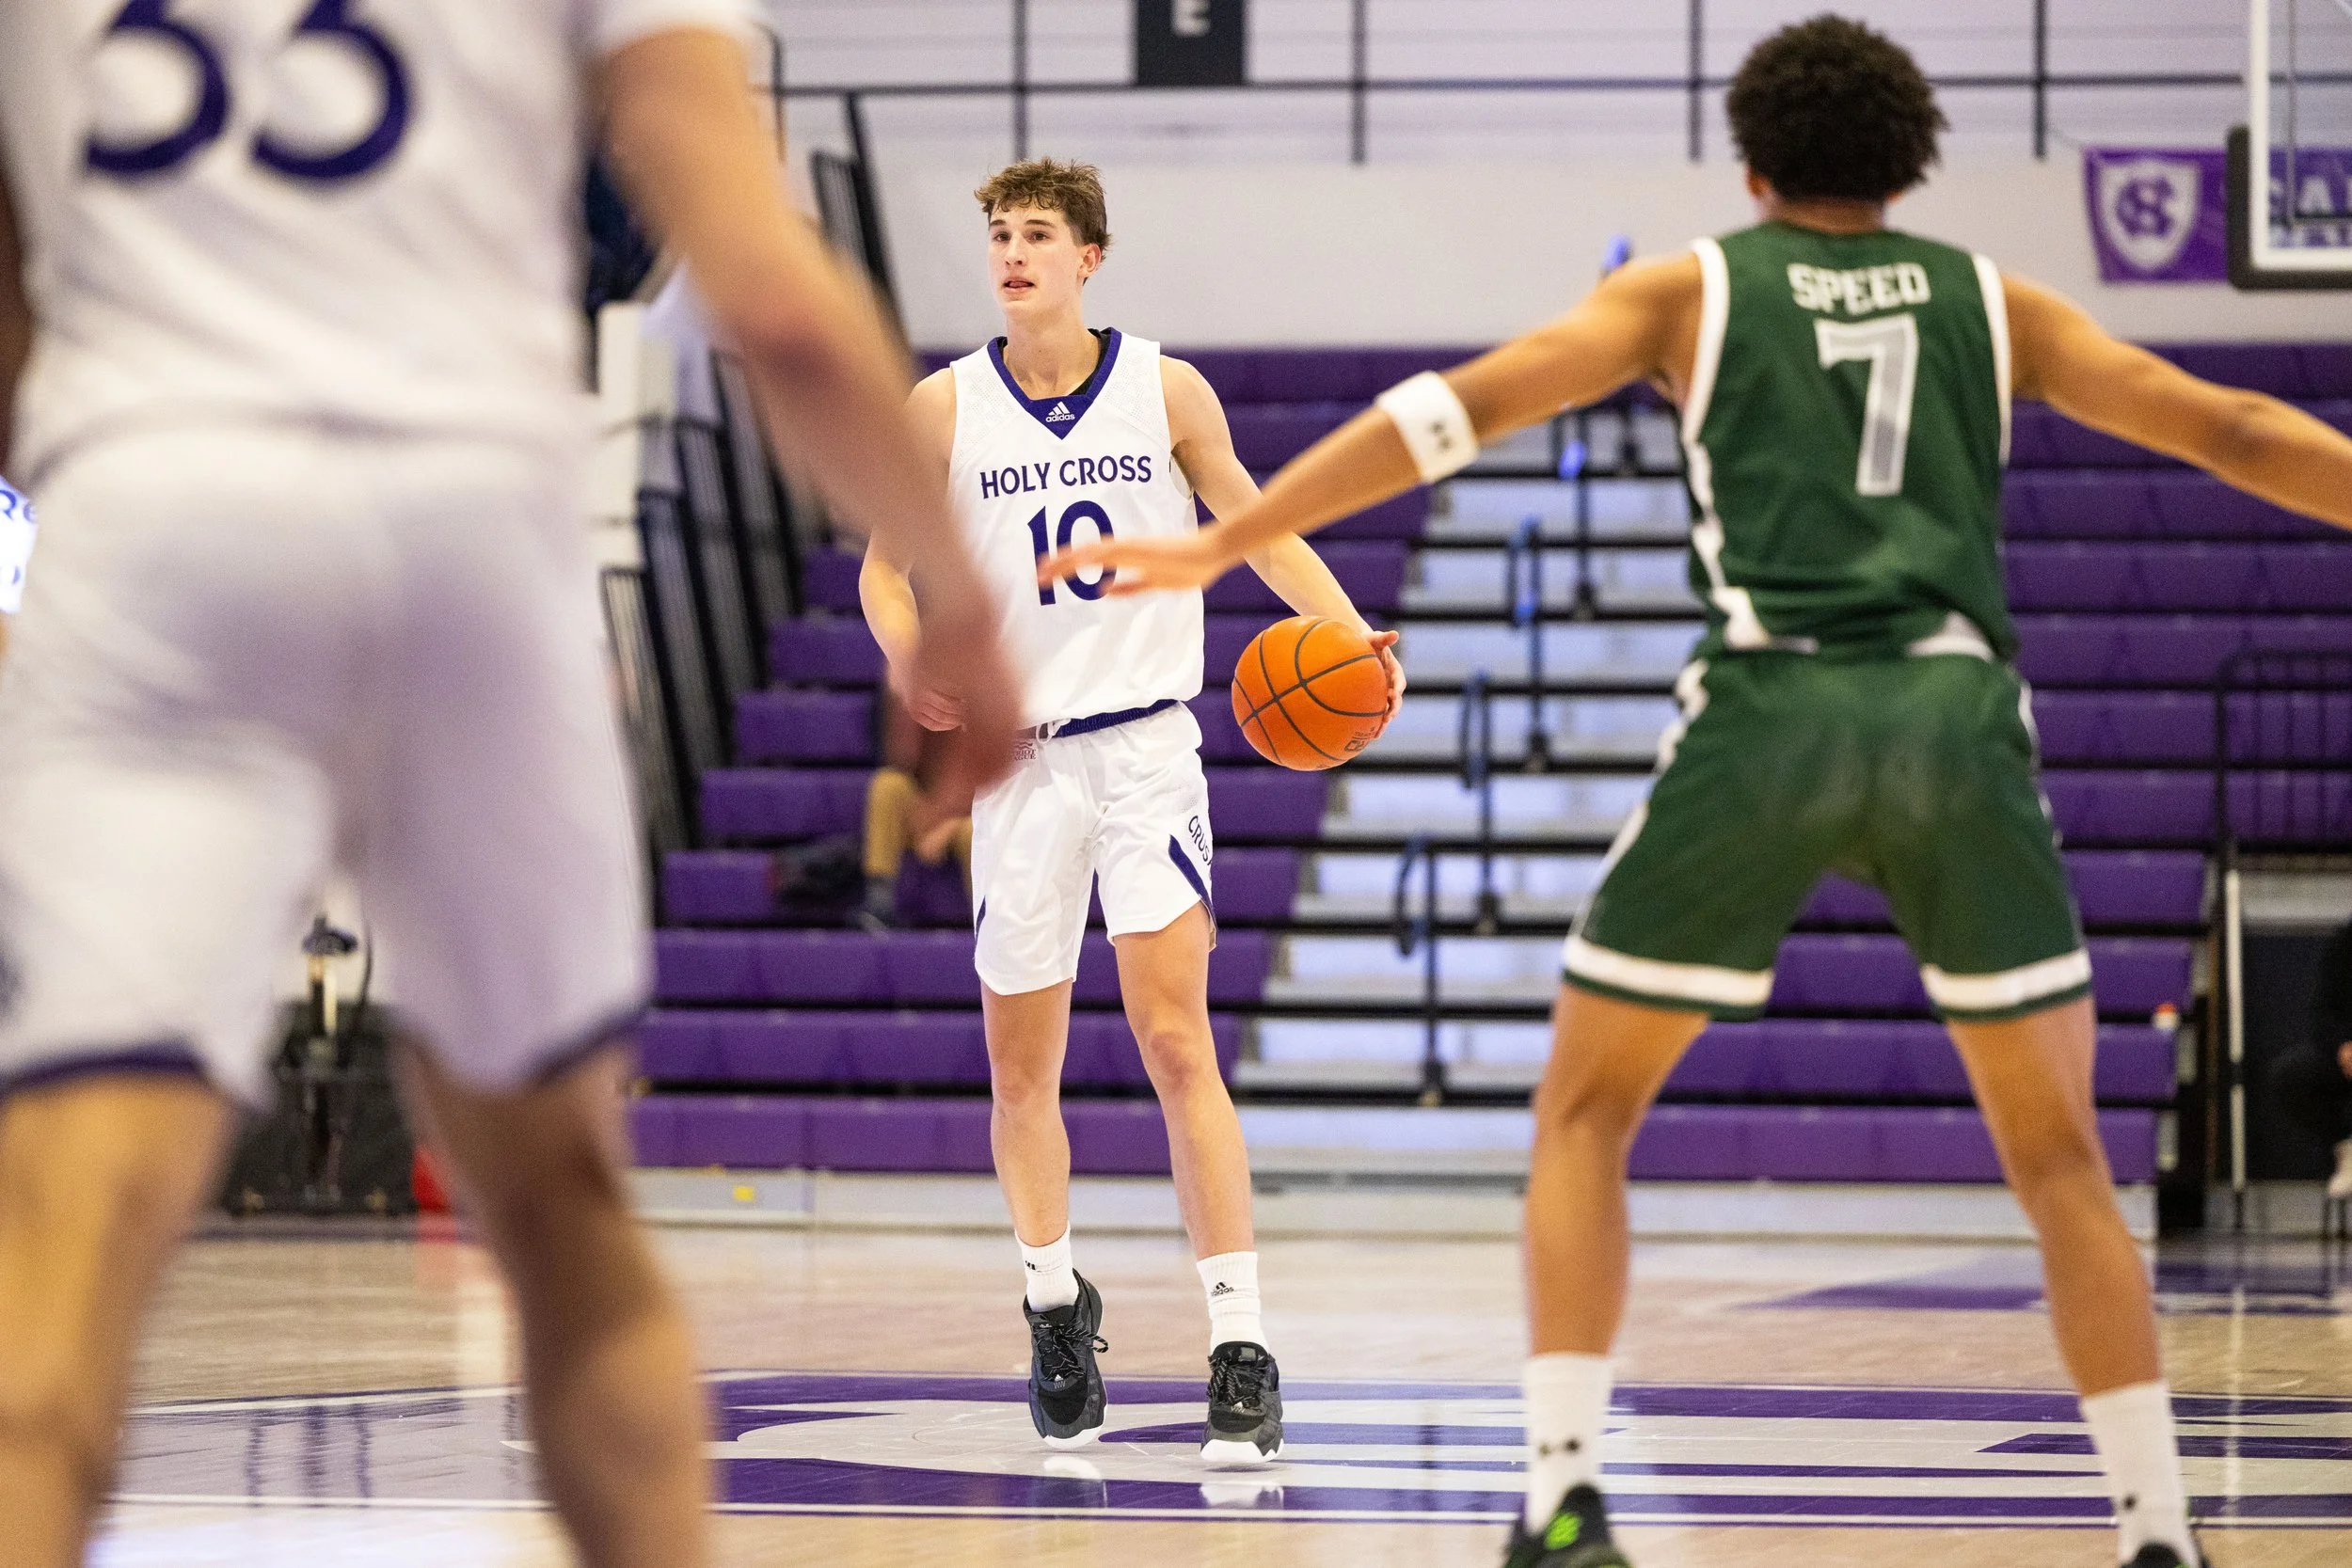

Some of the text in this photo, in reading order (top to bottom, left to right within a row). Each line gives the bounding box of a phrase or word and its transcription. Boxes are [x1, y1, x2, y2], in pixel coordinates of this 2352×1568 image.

[1788, 262, 1931, 315] SPEED
[1045, 413, 1075, 422] adidas
[1814, 312, 1919, 496] 7
[979, 455, 1152, 499] HOLY CROSS
[1027, 500, 1118, 606] 10
[1188, 816, 1212, 865] CRUS
